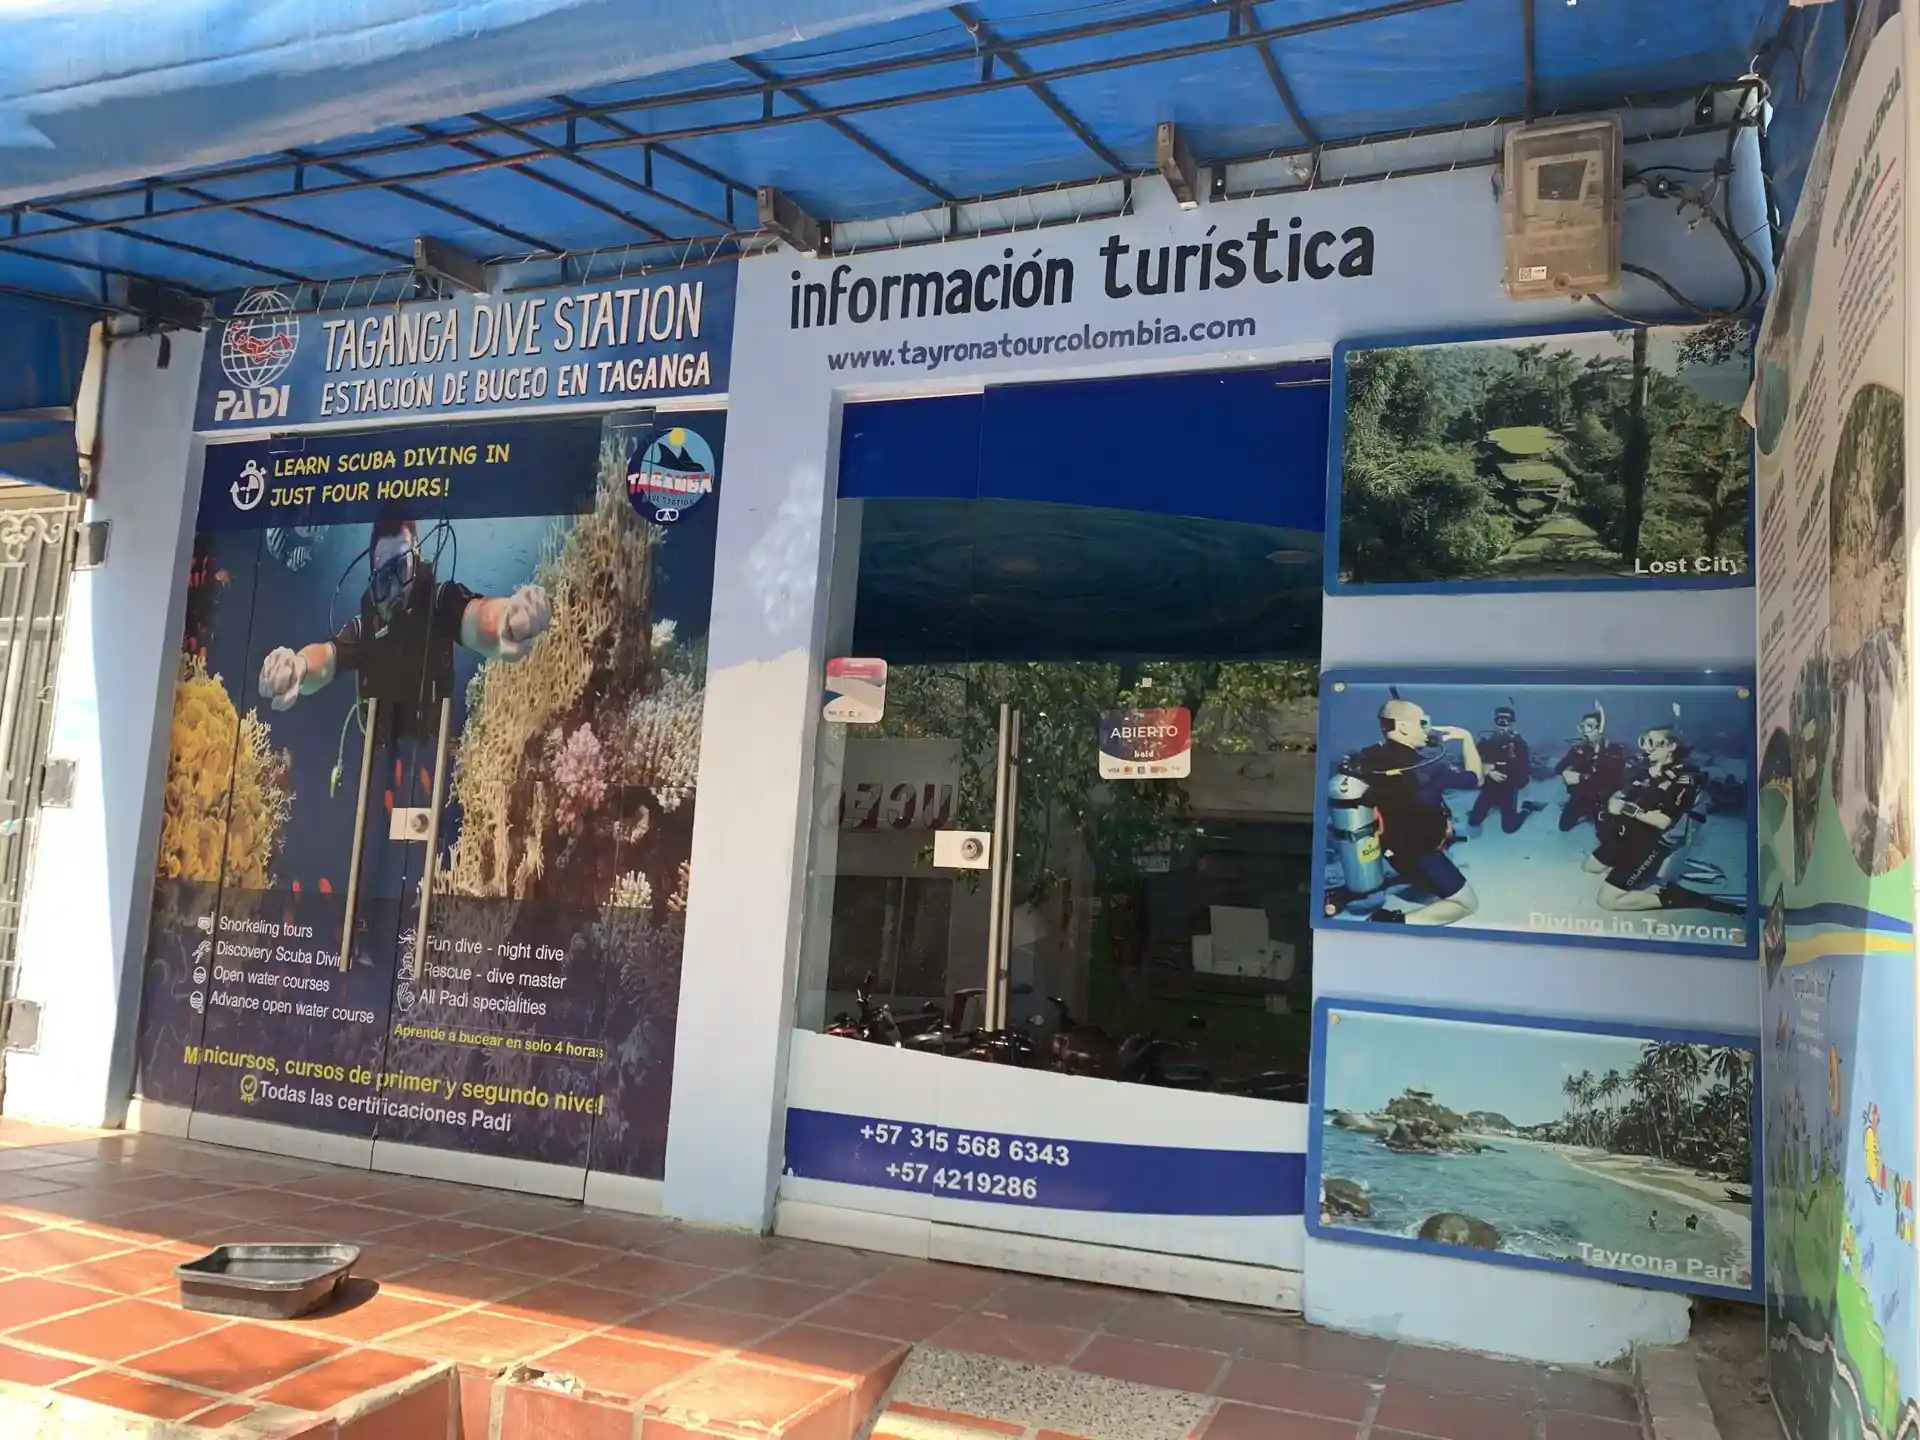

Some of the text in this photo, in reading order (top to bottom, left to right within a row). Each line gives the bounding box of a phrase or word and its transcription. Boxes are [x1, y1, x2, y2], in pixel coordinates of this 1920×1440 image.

[789, 216, 1375, 330] información turística
[323, 280, 704, 374] TAGANGA DIVE STATION
[827, 313, 1256, 371] www.tayronatourcolombia.com
[320, 351, 711, 417] ESTACIÓN DE BUCEO EN TAGANGA
[214, 384, 290, 422] PADI
[273, 443, 511, 477] LEARN SCUBA DIVING IN
[269, 478, 450, 507] JUST FOUR HOURS!
[1634, 555, 1740, 576] Lost City
[1109, 725, 1179, 739] ABIERTO
[219, 916, 313, 939] Snorkeling tours
[1612, 916, 1634, 933] in
[216, 940, 353, 971] Discovery Scuba Divi
[426, 935, 451, 952] Fun
[455, 937, 483, 955] dive
[497, 941, 531, 962] night
[535, 944, 564, 962] dive
[213, 965, 330, 993] Open water courses
[423, 962, 472, 980] Rescue
[486, 967, 515, 985] dive
[519, 972, 567, 990] master
[208, 989, 375, 1025] Advance open water course
[419, 988, 547, 1016] All Padi specialities
[394, 1023, 604, 1059] Aprende a bucear en solo 4 horas
[183, 1044, 605, 1116] Minicursos, cursos de primer y segundo nivel
[260, 1080, 512, 1133] Todas las certificaciones Padi
[859, 1123, 1070, 1167] +57 315 568 6343
[885, 1162, 1038, 1200] +57 4219286
[1577, 1241, 1678, 1273] Tayrona
